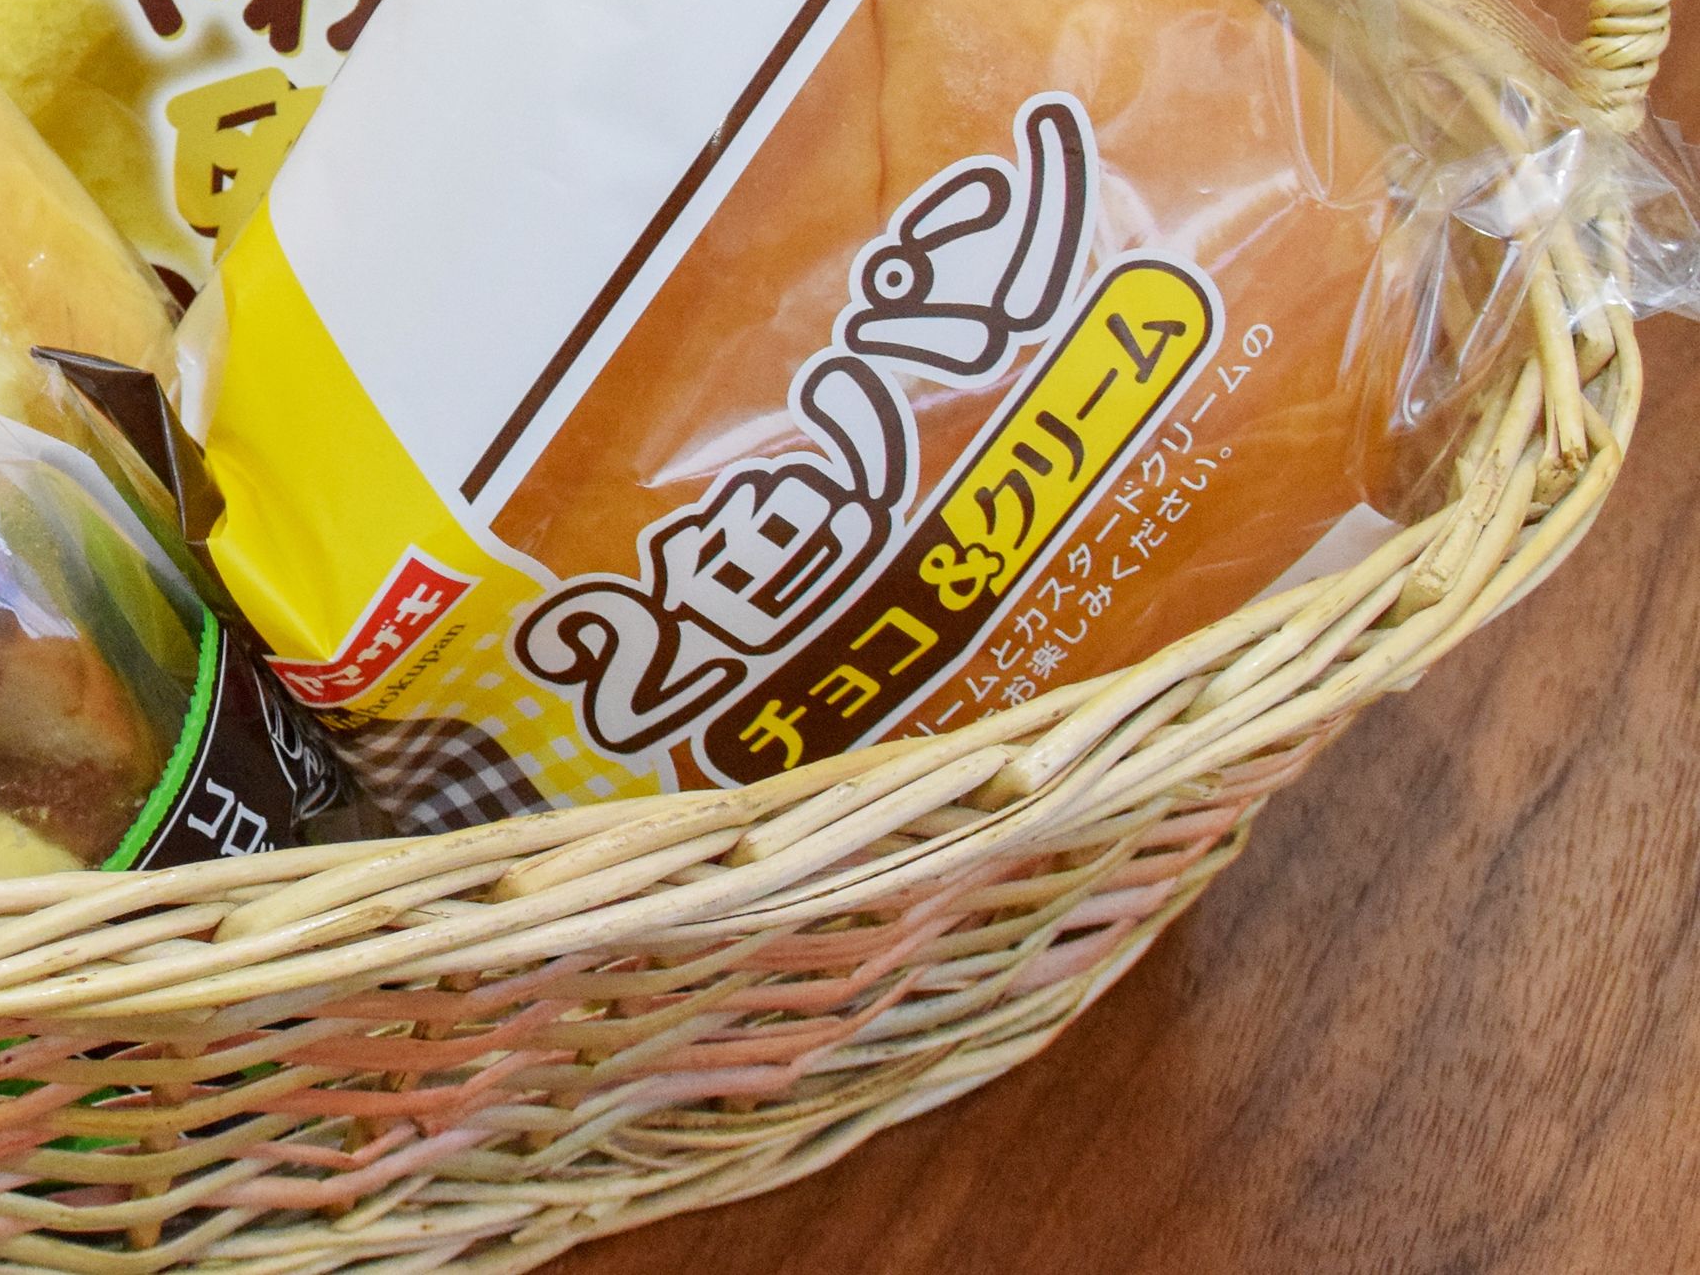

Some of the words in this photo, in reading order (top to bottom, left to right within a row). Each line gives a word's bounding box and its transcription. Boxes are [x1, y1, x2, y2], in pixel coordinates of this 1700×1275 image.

[283, 581, 445, 699] ヤマザキ
[513, 99, 1089, 755] 2色パン
[736, 310, 1189, 772] チョコ&クリーム
